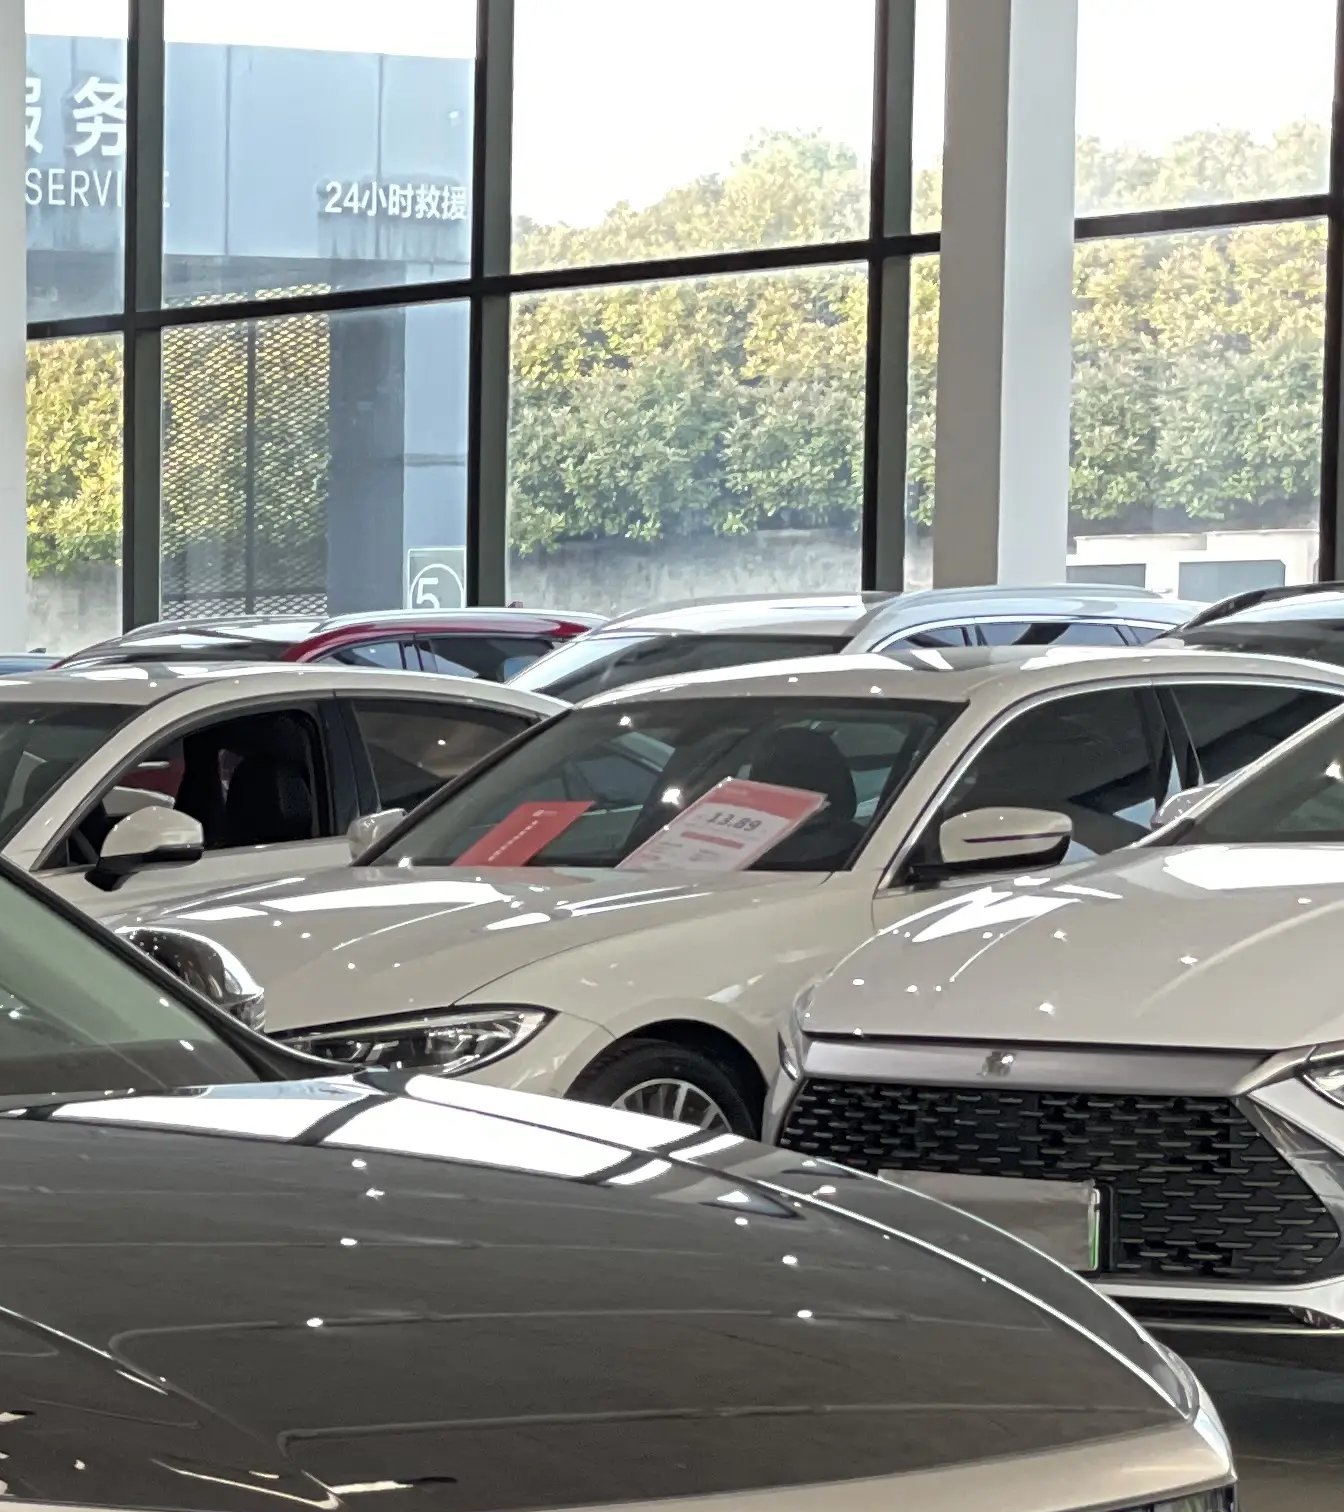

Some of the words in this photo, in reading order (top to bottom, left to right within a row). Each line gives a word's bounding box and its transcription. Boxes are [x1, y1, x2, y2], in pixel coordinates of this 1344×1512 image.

[324, 181, 469, 221] 24小时救援
[706, 811, 763, 832] 13.89
